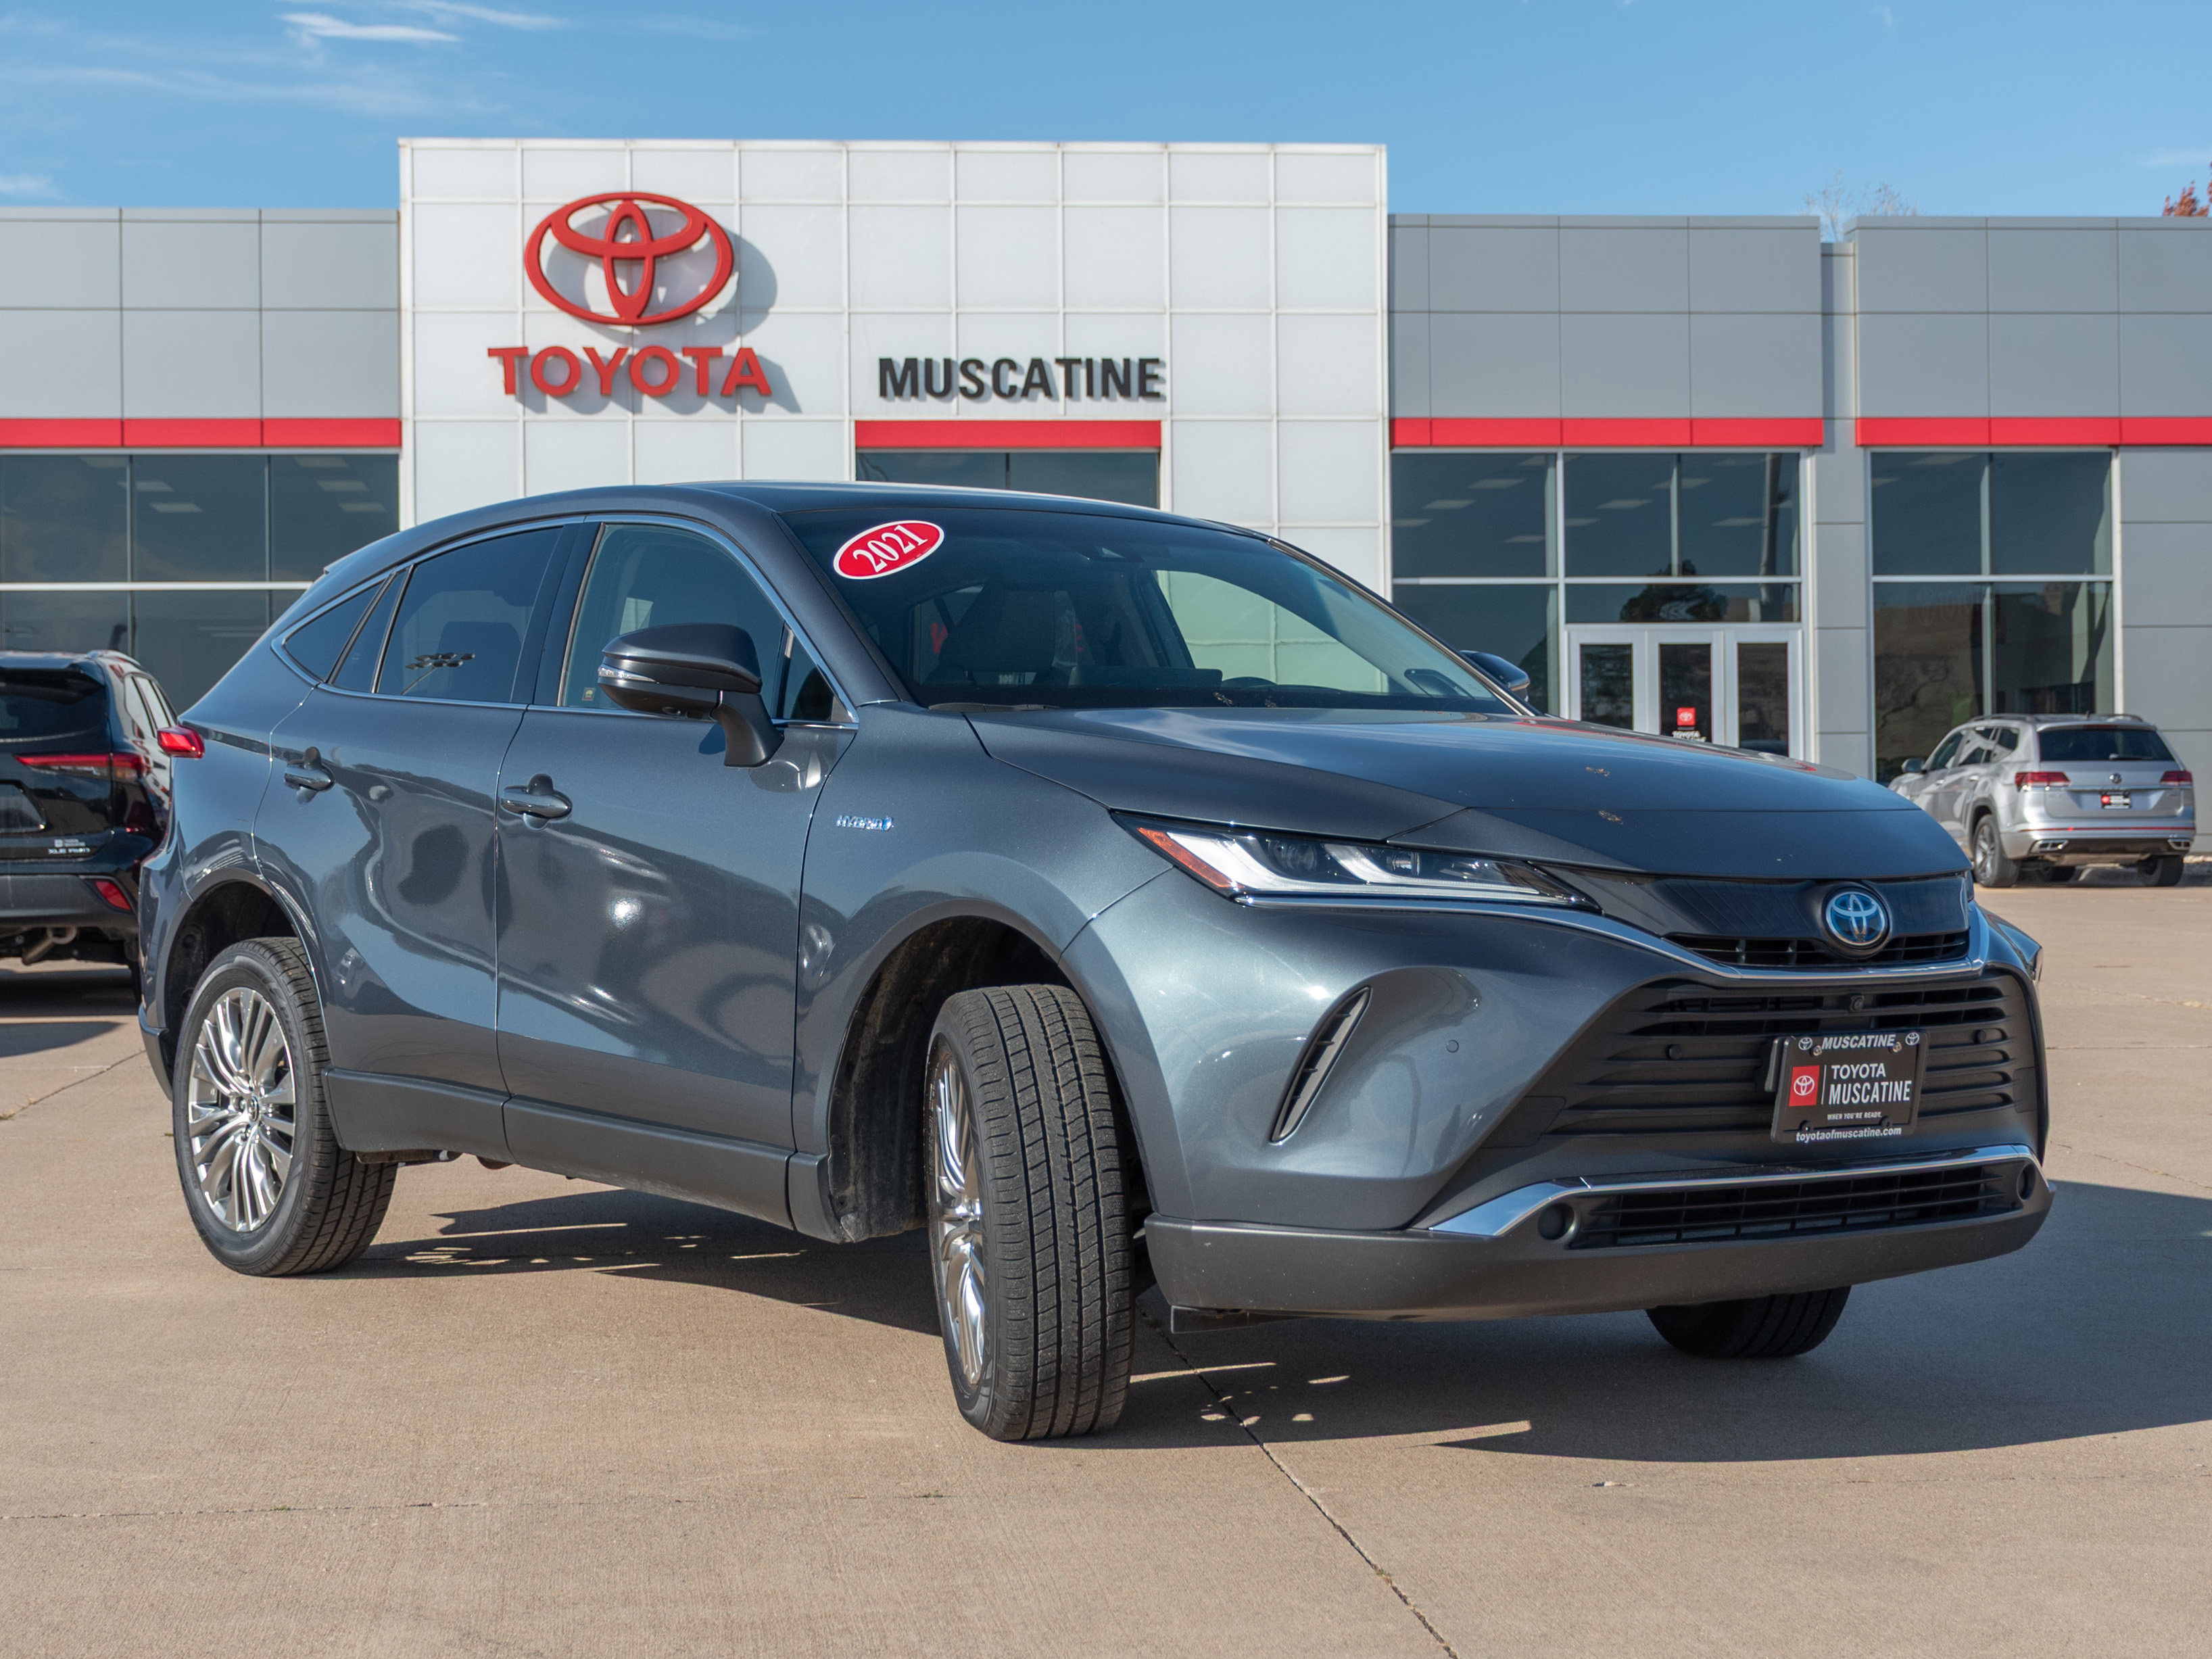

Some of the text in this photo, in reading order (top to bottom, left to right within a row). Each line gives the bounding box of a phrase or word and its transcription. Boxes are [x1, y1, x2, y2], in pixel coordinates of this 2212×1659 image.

[487, 345, 772, 397] TOYOTA
[878, 358, 1161, 398] MUSCATINE
[852, 525, 928, 573] 2021
[1821, 1034, 1896, 1049] MUSCATINE
[1831, 1063, 1886, 1080] TOYOTA
[1829, 1080, 1912, 1105] MUSCATINE
[1796, 1127, 1902, 1143] toyotaofmuscatine.com
